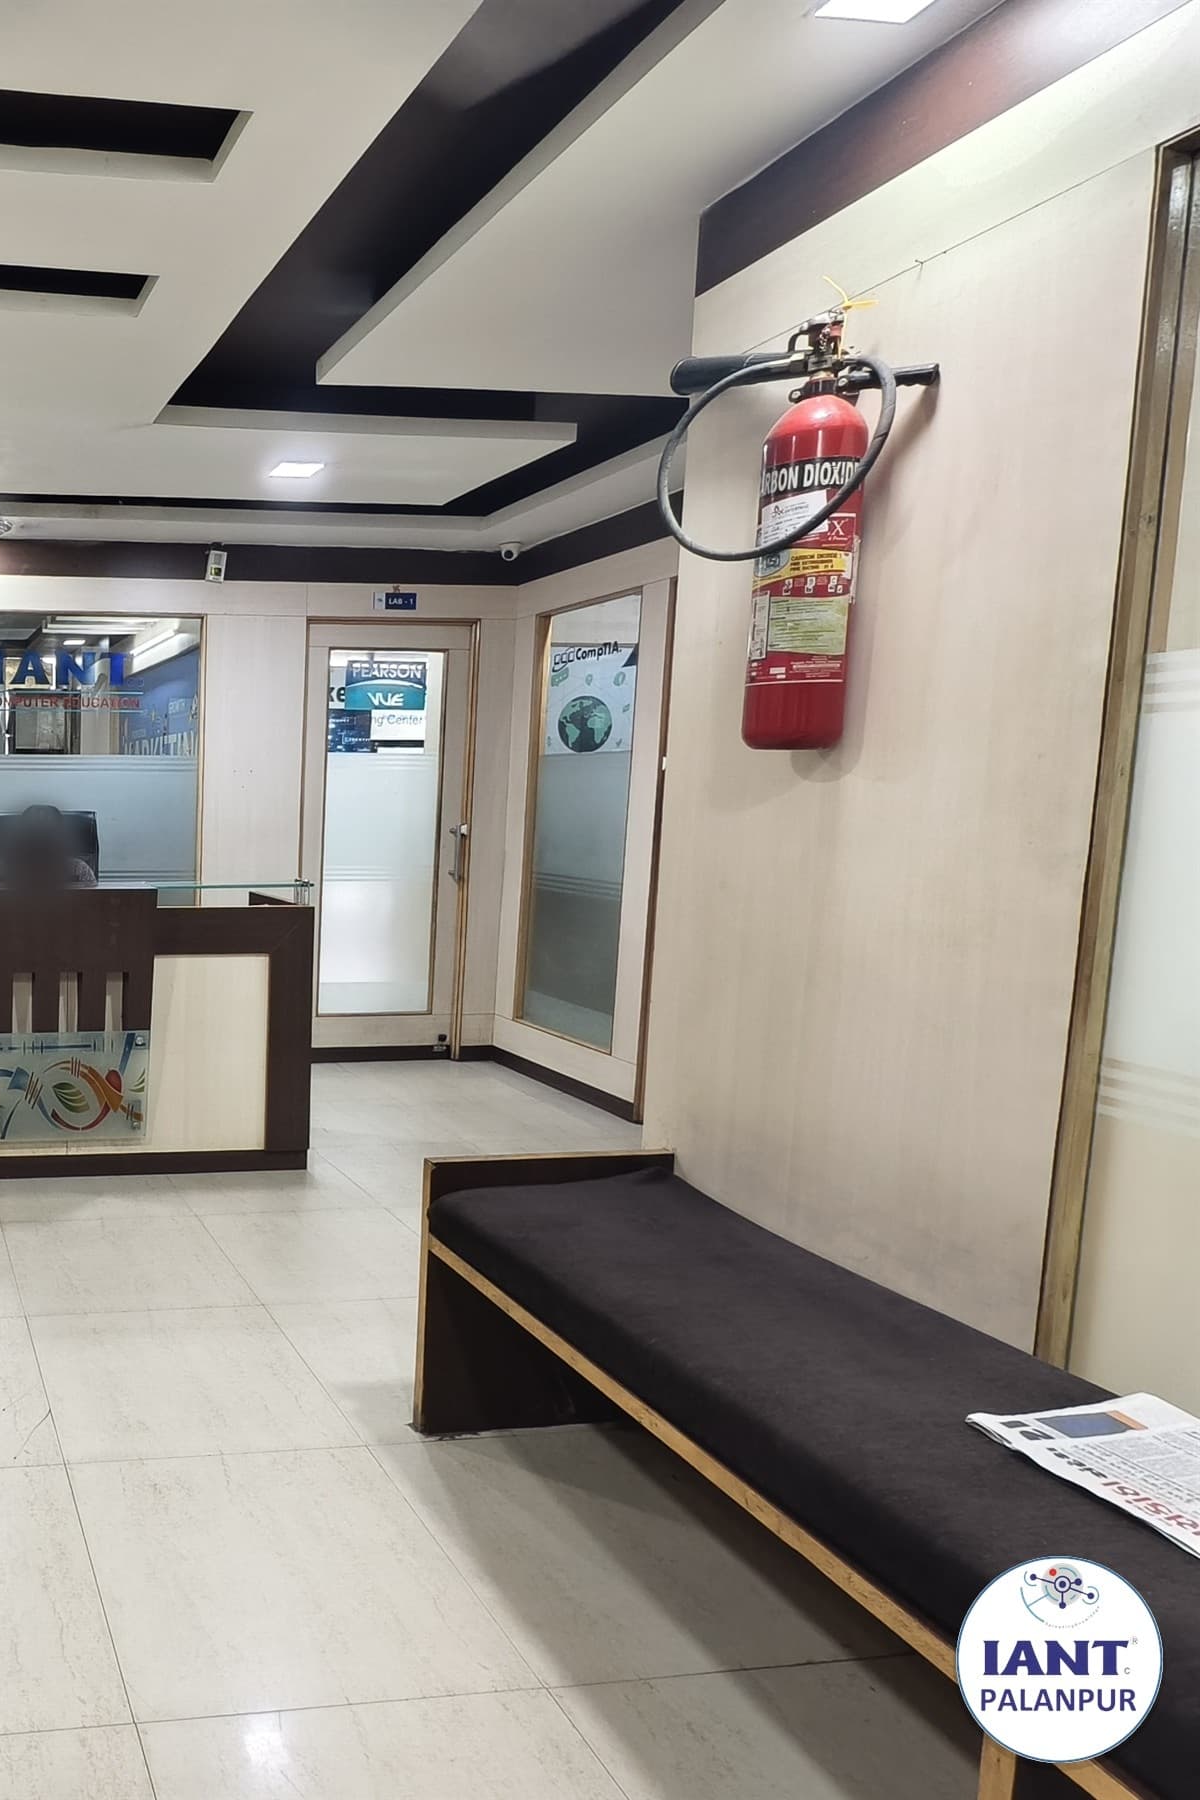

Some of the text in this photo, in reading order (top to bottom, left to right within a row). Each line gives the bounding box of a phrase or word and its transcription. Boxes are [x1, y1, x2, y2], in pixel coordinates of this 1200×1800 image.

[388, 597, 403, 605] LAB
[352, 662, 423, 678] PEARSON
[367, 692, 404, 706] VUE
[387, 714, 423, 725] Center
